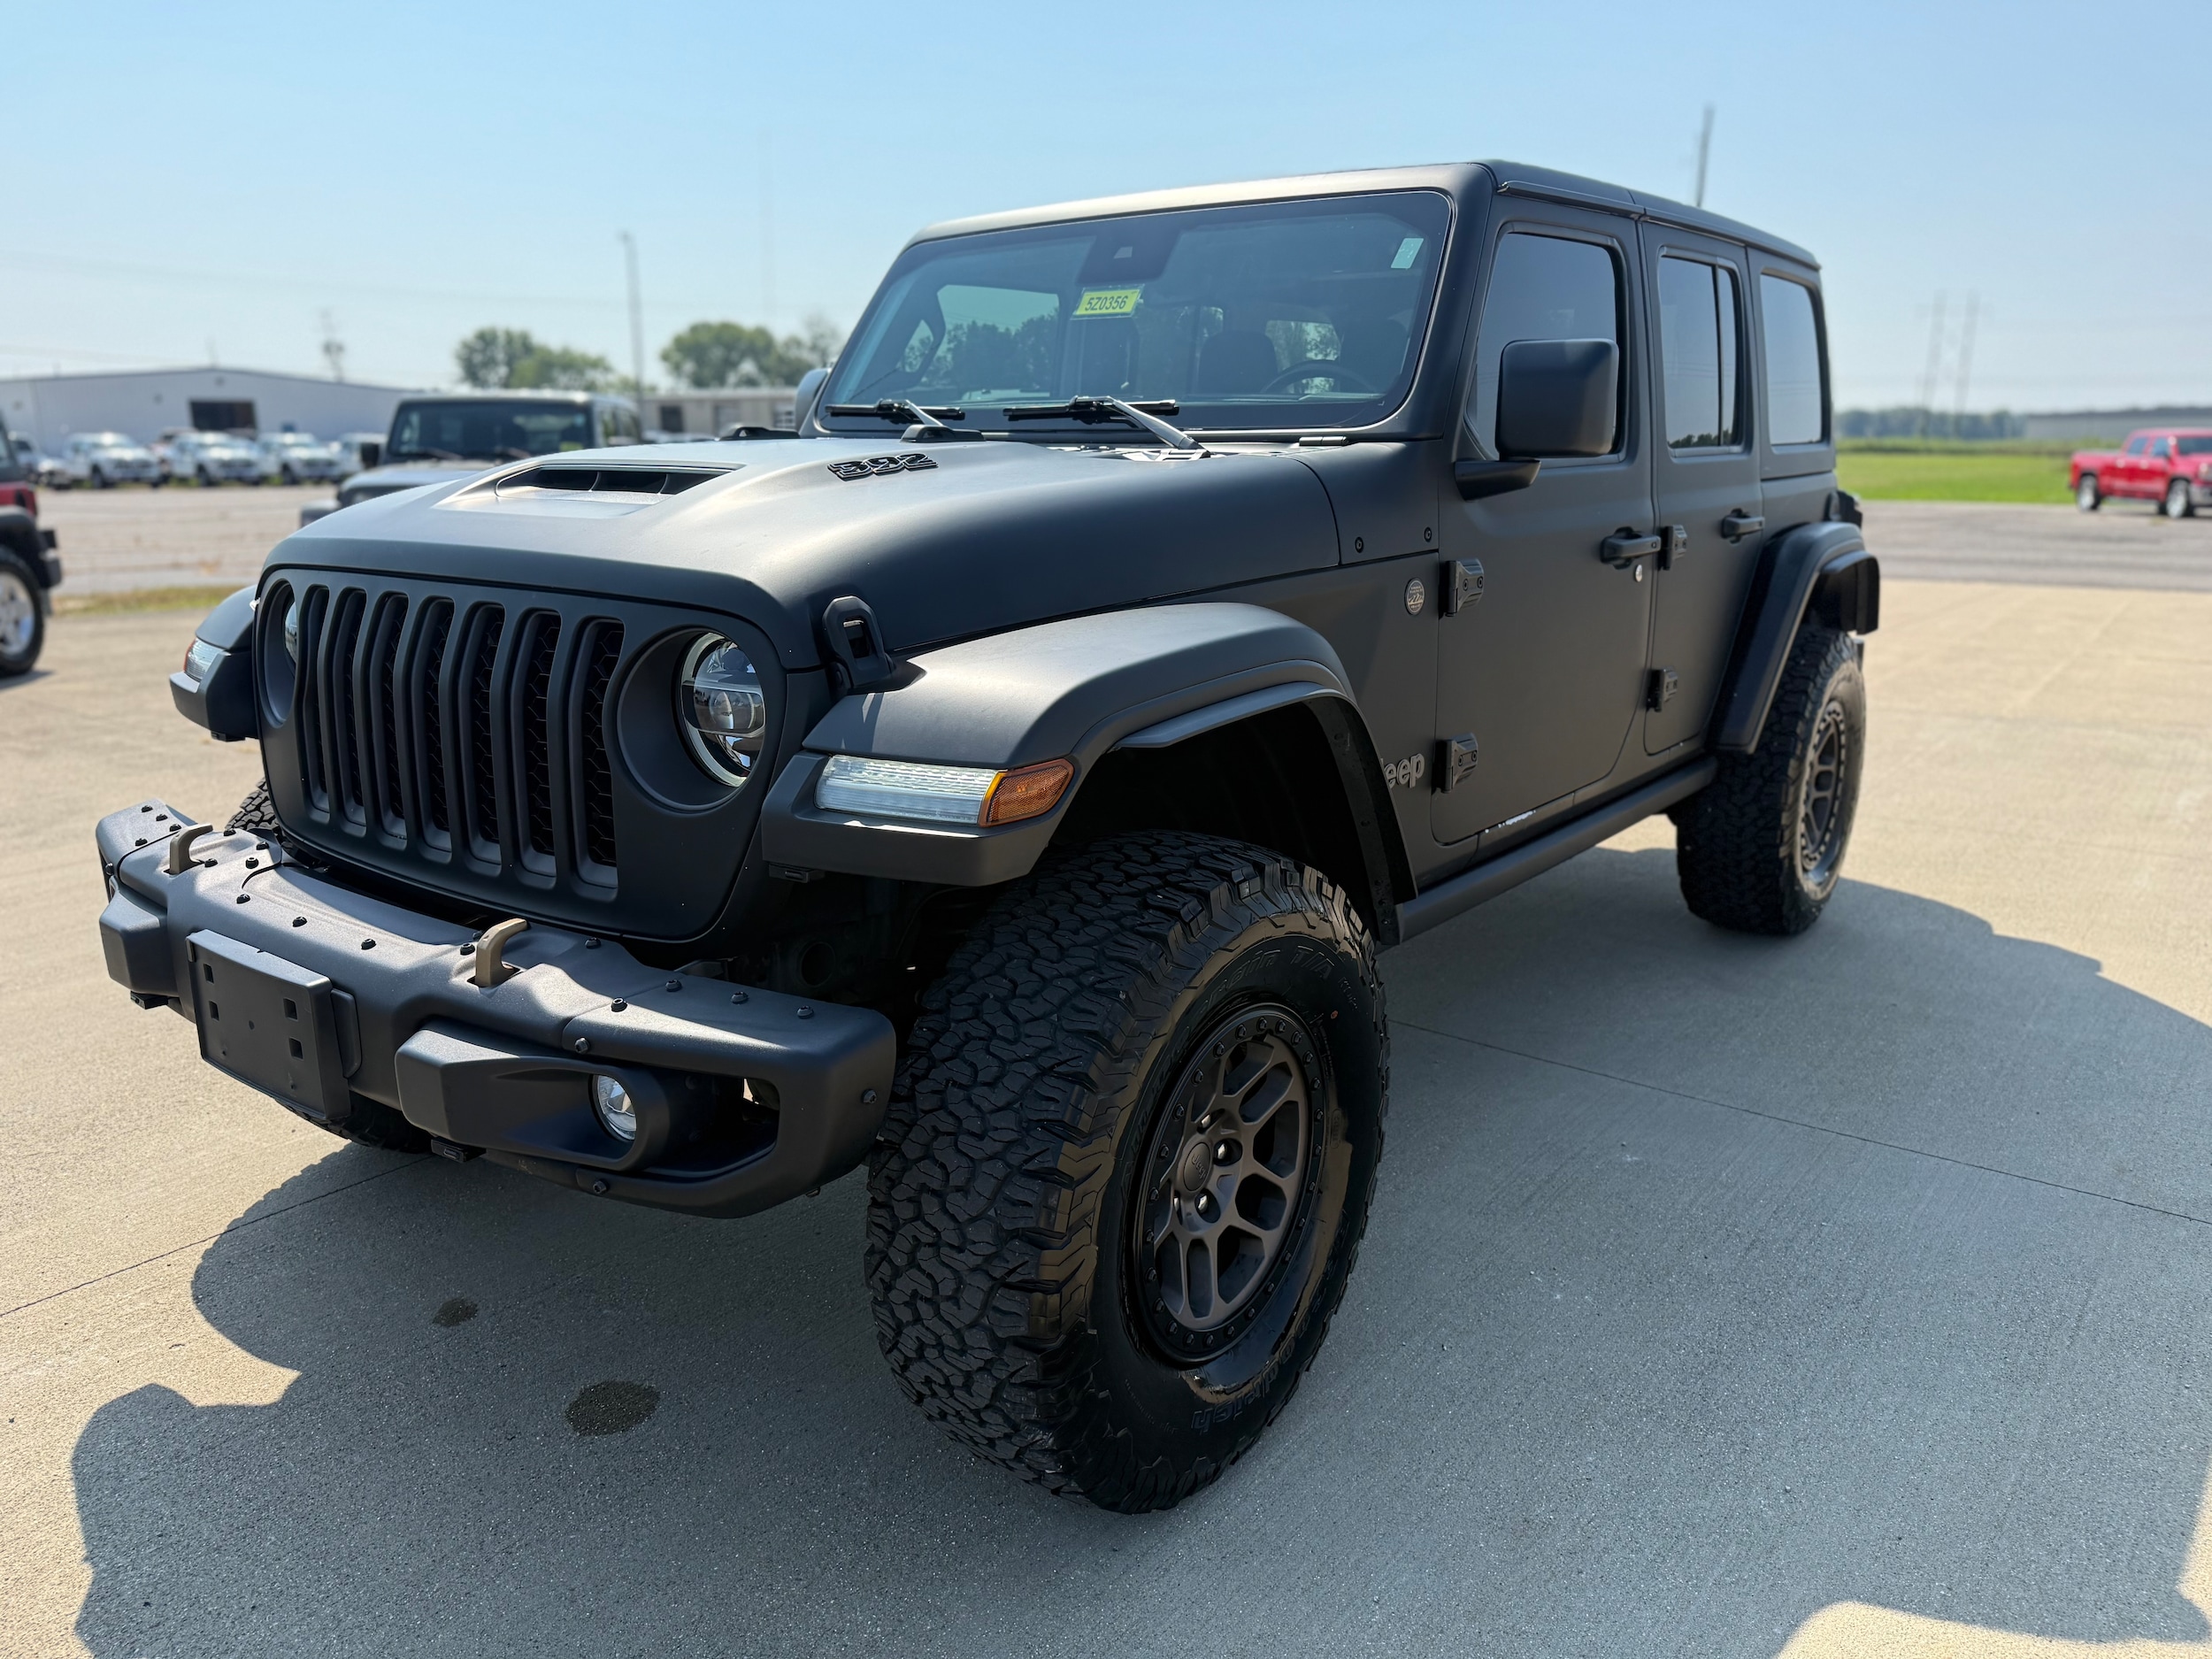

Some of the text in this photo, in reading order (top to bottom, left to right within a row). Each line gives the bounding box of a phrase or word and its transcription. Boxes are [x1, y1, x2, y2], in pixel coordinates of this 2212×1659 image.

[1084, 296, 1128, 311] 5Z0356
[826, 453, 939, 481] 392
[1380, 753, 1425, 789] eep
